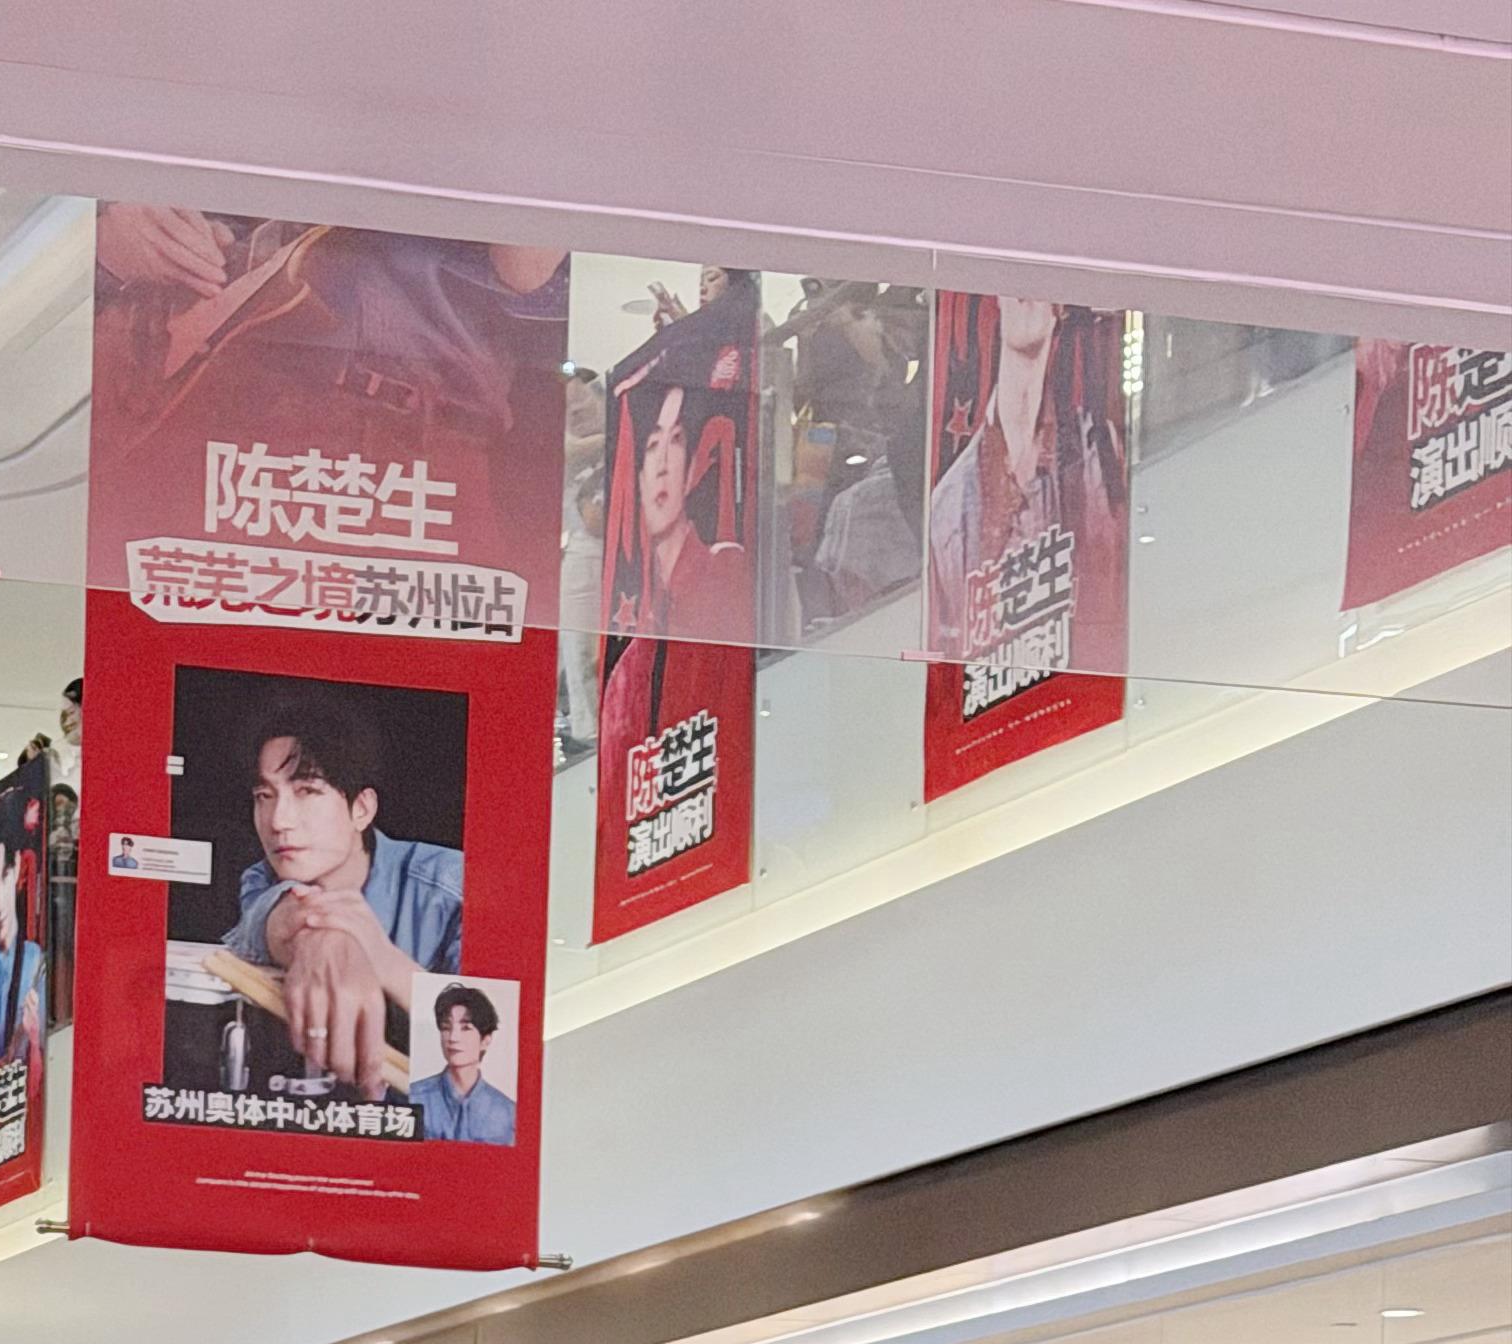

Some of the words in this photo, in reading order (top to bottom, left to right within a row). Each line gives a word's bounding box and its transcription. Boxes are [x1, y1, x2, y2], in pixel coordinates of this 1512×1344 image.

[205, 441, 459, 555] 陈楚生
[138, 546, 516, 636] 荒芜之境苏州站
[963, 524, 1074, 657] 陈楚生
[626, 709, 718, 820] 陈楚生
[144, 1086, 415, 1137] 苏州奥体中心体育场
